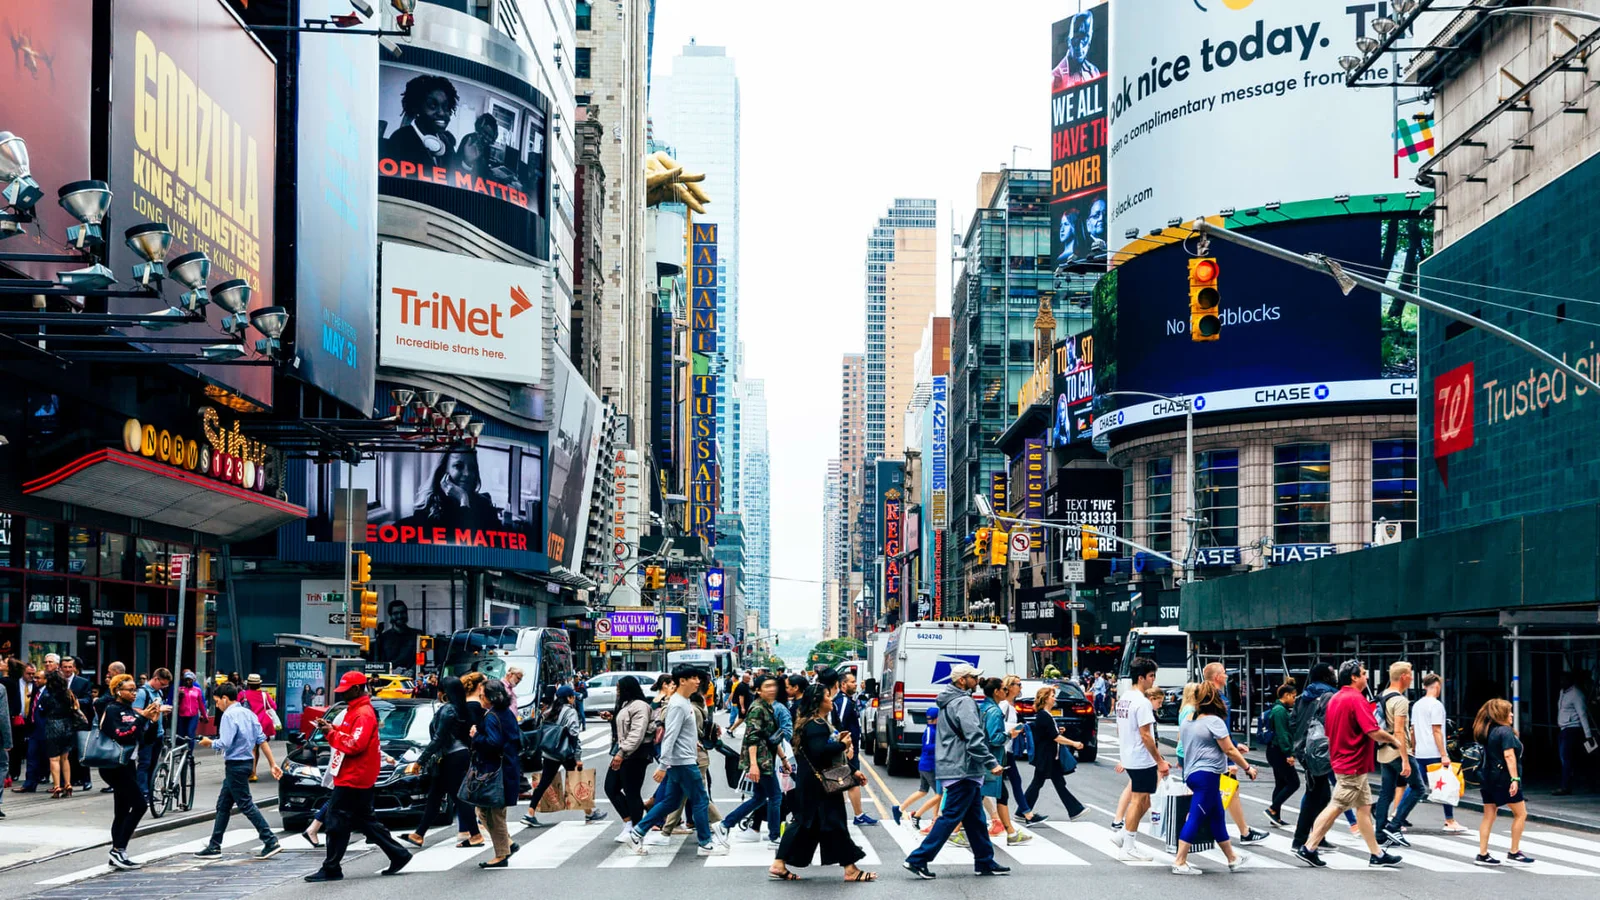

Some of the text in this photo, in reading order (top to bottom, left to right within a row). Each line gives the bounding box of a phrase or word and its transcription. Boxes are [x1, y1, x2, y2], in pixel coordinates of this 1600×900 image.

[1138, 54, 1190, 101] nice
[1200, 20, 1329, 72] today.
[1053, 84, 1102, 126] WE ALL
[1124, 134, 1128, 145] a
[1130, 95, 1216, 140] complimentary
[1221, 78, 1297, 104] message
[1304, 70, 1345, 87] from
[135, 30, 259, 239] GODZILLA
[1053, 124, 1088, 161] HAVE
[455, 171, 529, 207] MATTER
[1053, 154, 1101, 196] POWER
[133, 148, 260, 273] KING OF THE MONSTERS
[1115, 187, 1153, 219] slack.com
[133, 191, 162, 223] LONG
[167, 215, 188, 245] LIVE
[192, 233, 210, 255] THE
[213, 248, 235, 278] KING
[236, 263, 251, 284] MAY
[252, 274, 260, 293] 31
[694, 224, 717, 351] MADAME
[392, 287, 504, 339] TriNet
[1166, 303, 1281, 336] No dblocks
[323, 323, 357, 369] MAY 31
[396, 335, 507, 360] Incredible starts here.
[933, 377, 946, 401] NEW
[1065, 376, 1077, 402] TO
[1255, 386, 1311, 402] CHASE
[1483, 352, 1567, 426] Trusted
[1099, 414, 1118, 430] CHASE
[1152, 399, 1191, 416] CHASE
[933, 443, 946, 489] STUDIOS
[1029, 443, 1042, 508] VICTORY
[613, 450, 627, 586] AMSTERDAM
[1065, 499, 1088, 511] TEXT
[1090, 499, 1115, 511] 'FIVE'
[1066, 511, 1117, 524] TO 313131
[366, 523, 528, 550] EOPLE MATTER
[886, 503, 899, 594] REGAL
[1065, 537, 1081, 551] AD
[1268, 545, 1333, 562] HASE
[614, 624, 628, 633] YOU
[629, 624, 646, 633] WISH
[1160, 606, 1180, 619] STEV
[287, 662, 322, 671] NEVER BEEN
[287, 670, 323, 679] NOMINATED
